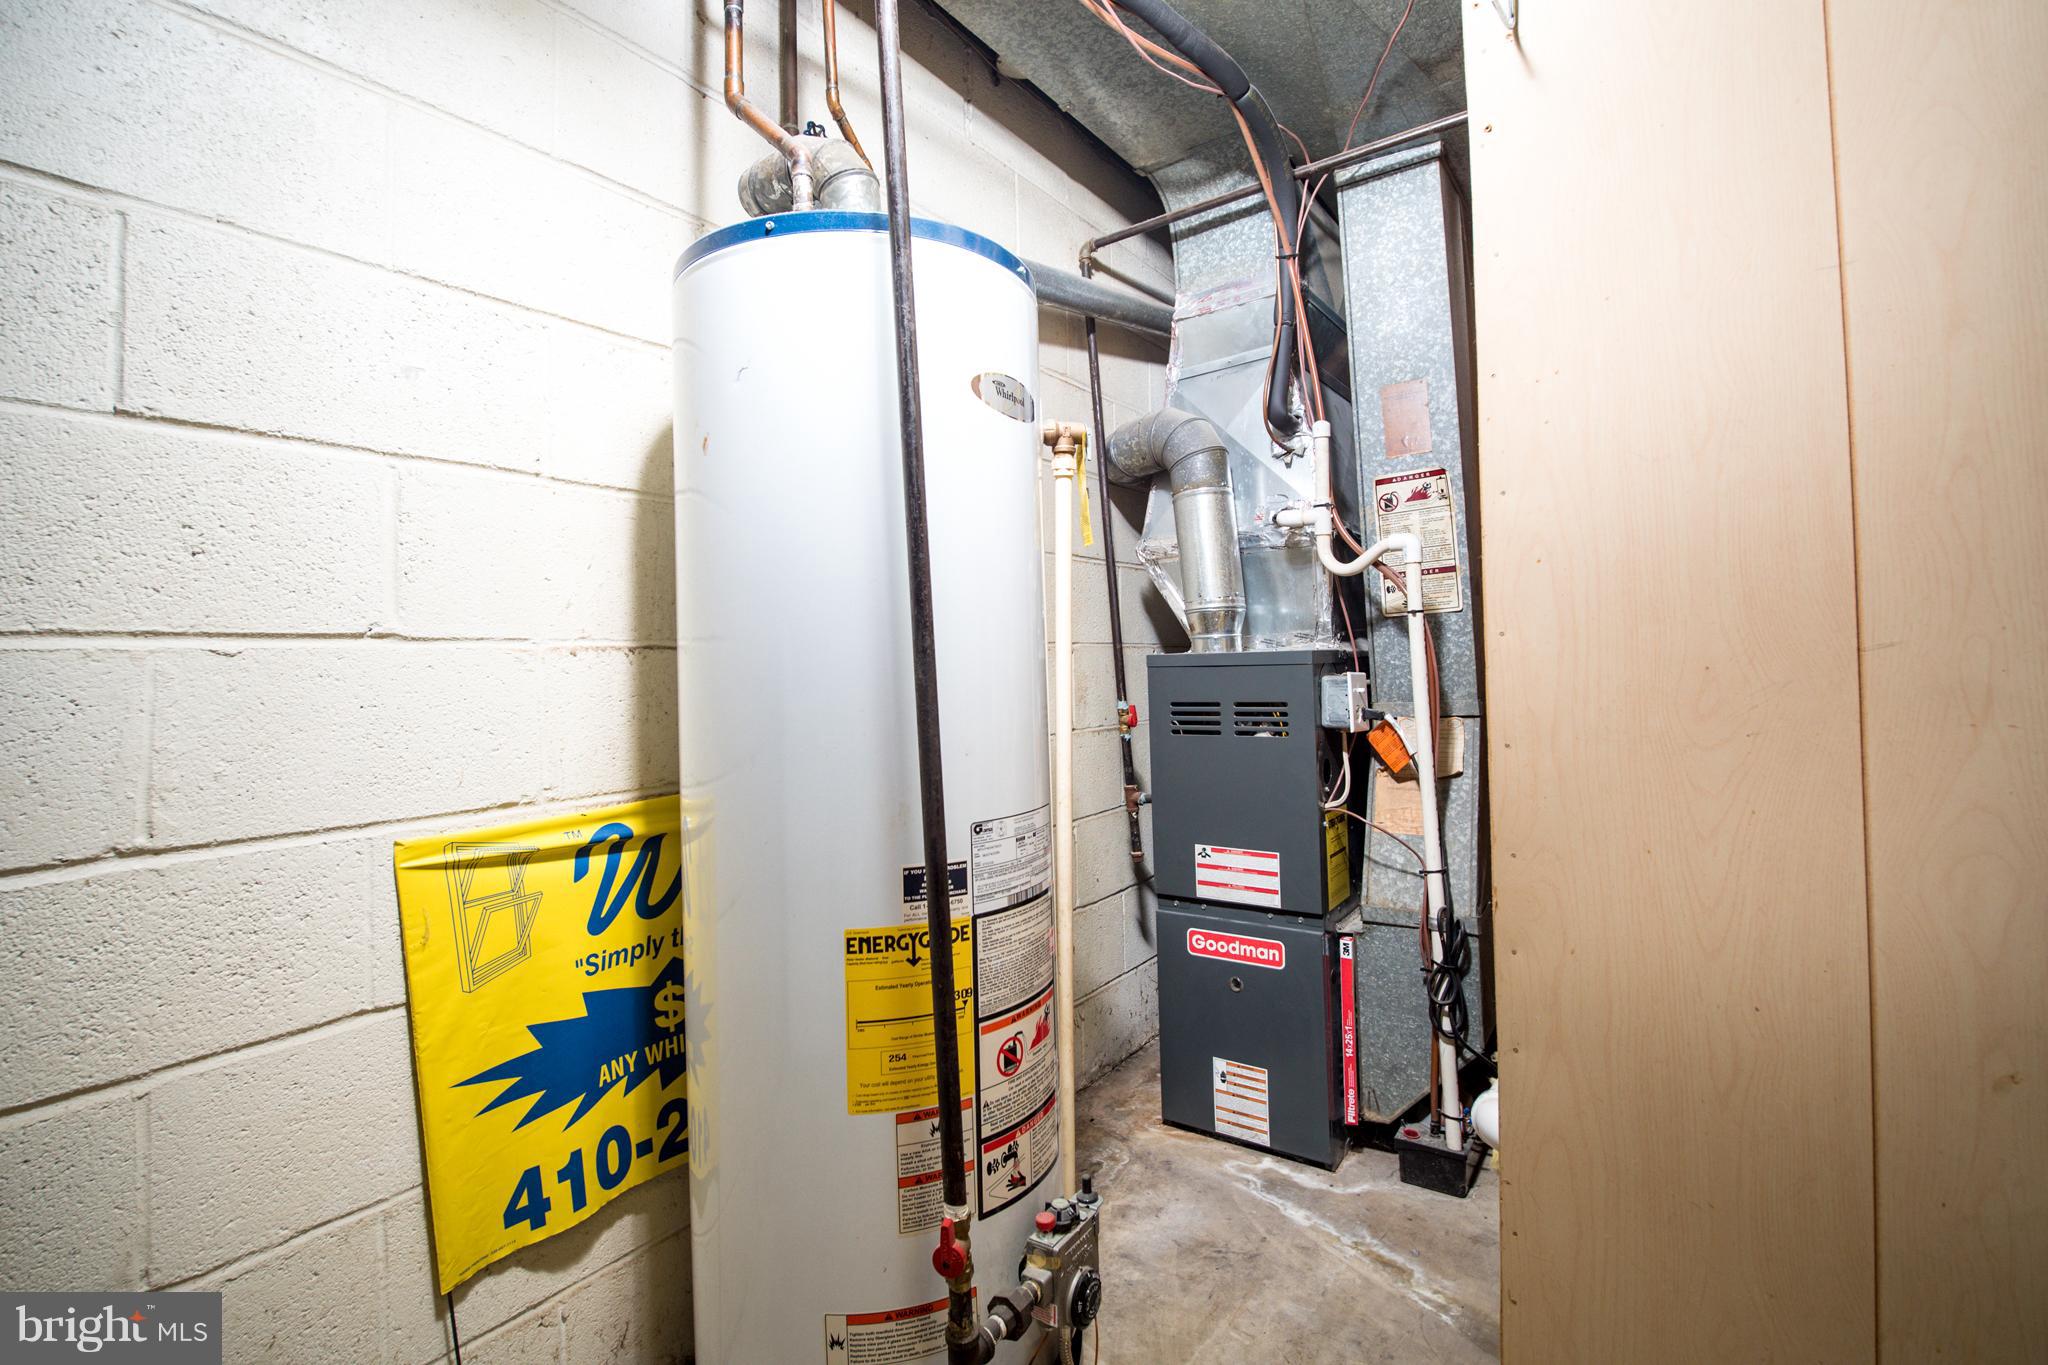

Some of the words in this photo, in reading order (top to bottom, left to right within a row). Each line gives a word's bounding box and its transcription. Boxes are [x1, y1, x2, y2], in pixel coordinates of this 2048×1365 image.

[995, 386, 1025, 407] Whirlpool
[1397, 472, 1431, 482] DANGER
[574, 822, 683, 936] W
[575, 935, 664, 977] "Simply
[1191, 934, 1280, 962] Goodman
[1343, 942, 1350, 956] 3M
[598, 1050, 638, 1088] ANY
[644, 1033, 685, 1066] WHI
[889, 1053, 907, 1063] 254
[1347, 1088, 1356, 1123] Filtrete
[1021, 1111, 1044, 1134] DANGER
[503, 1097, 689, 1231] 410-2
[895, 1303, 933, 1318] WARNING
